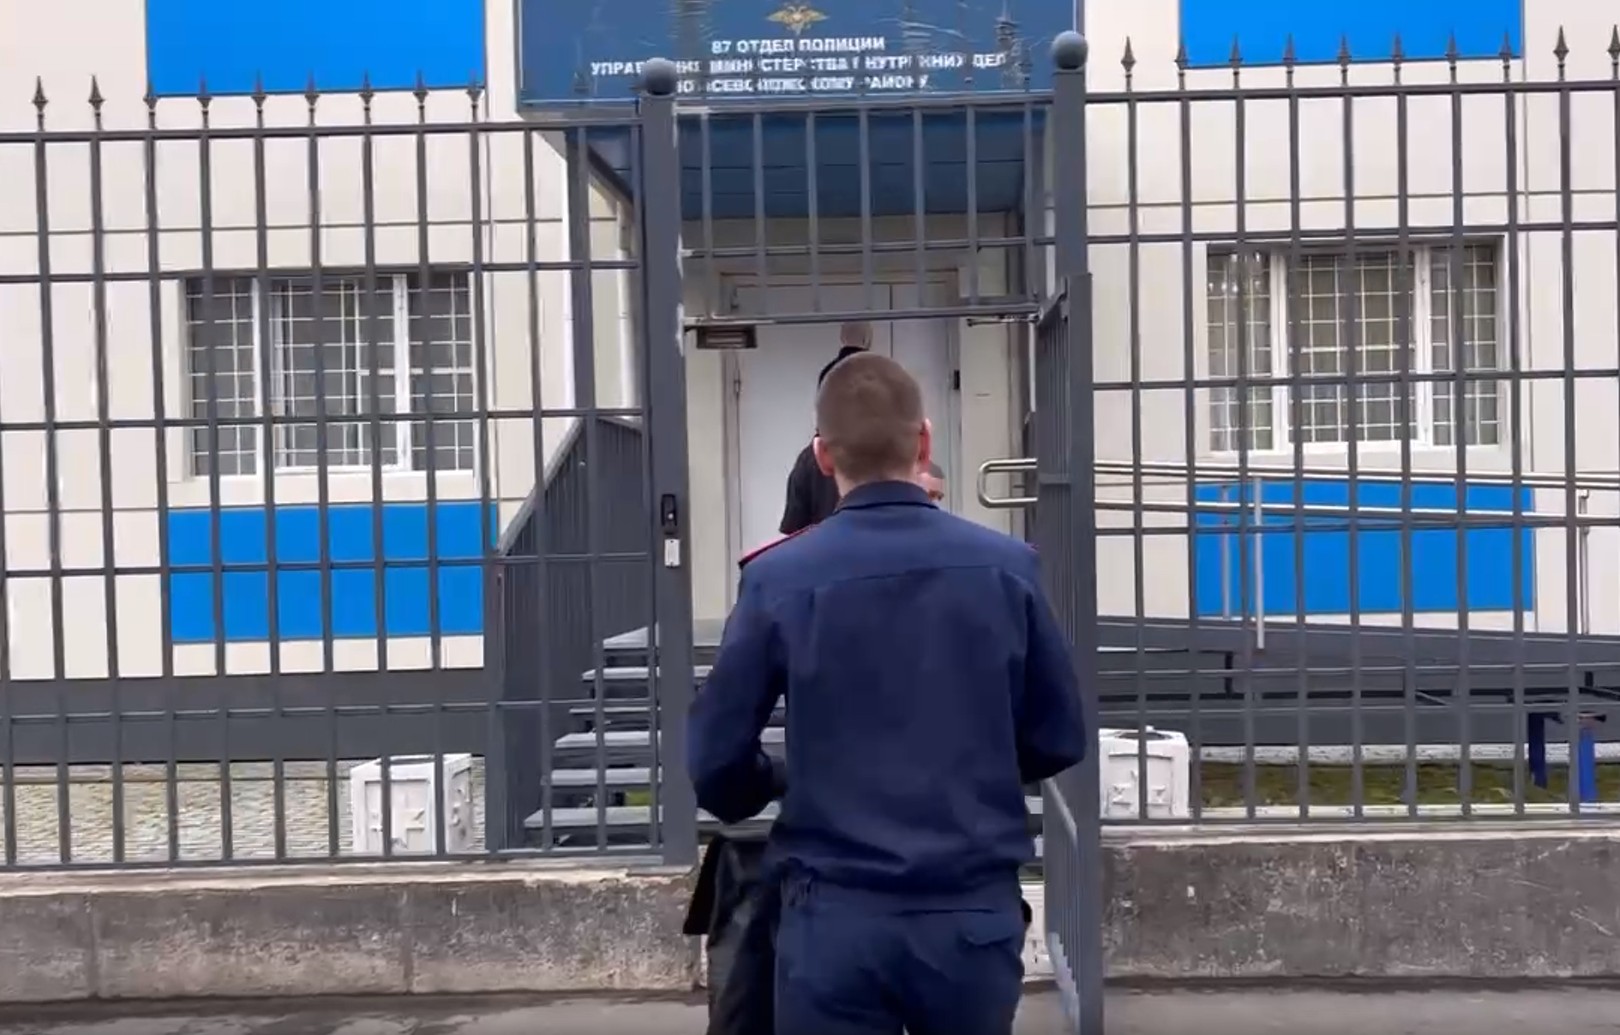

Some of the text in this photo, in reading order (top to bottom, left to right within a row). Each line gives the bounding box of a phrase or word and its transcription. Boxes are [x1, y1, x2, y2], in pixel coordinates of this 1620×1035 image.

[711, 36, 885, 54] 87 ОТДЕЛ ПОЛИЦИИ
